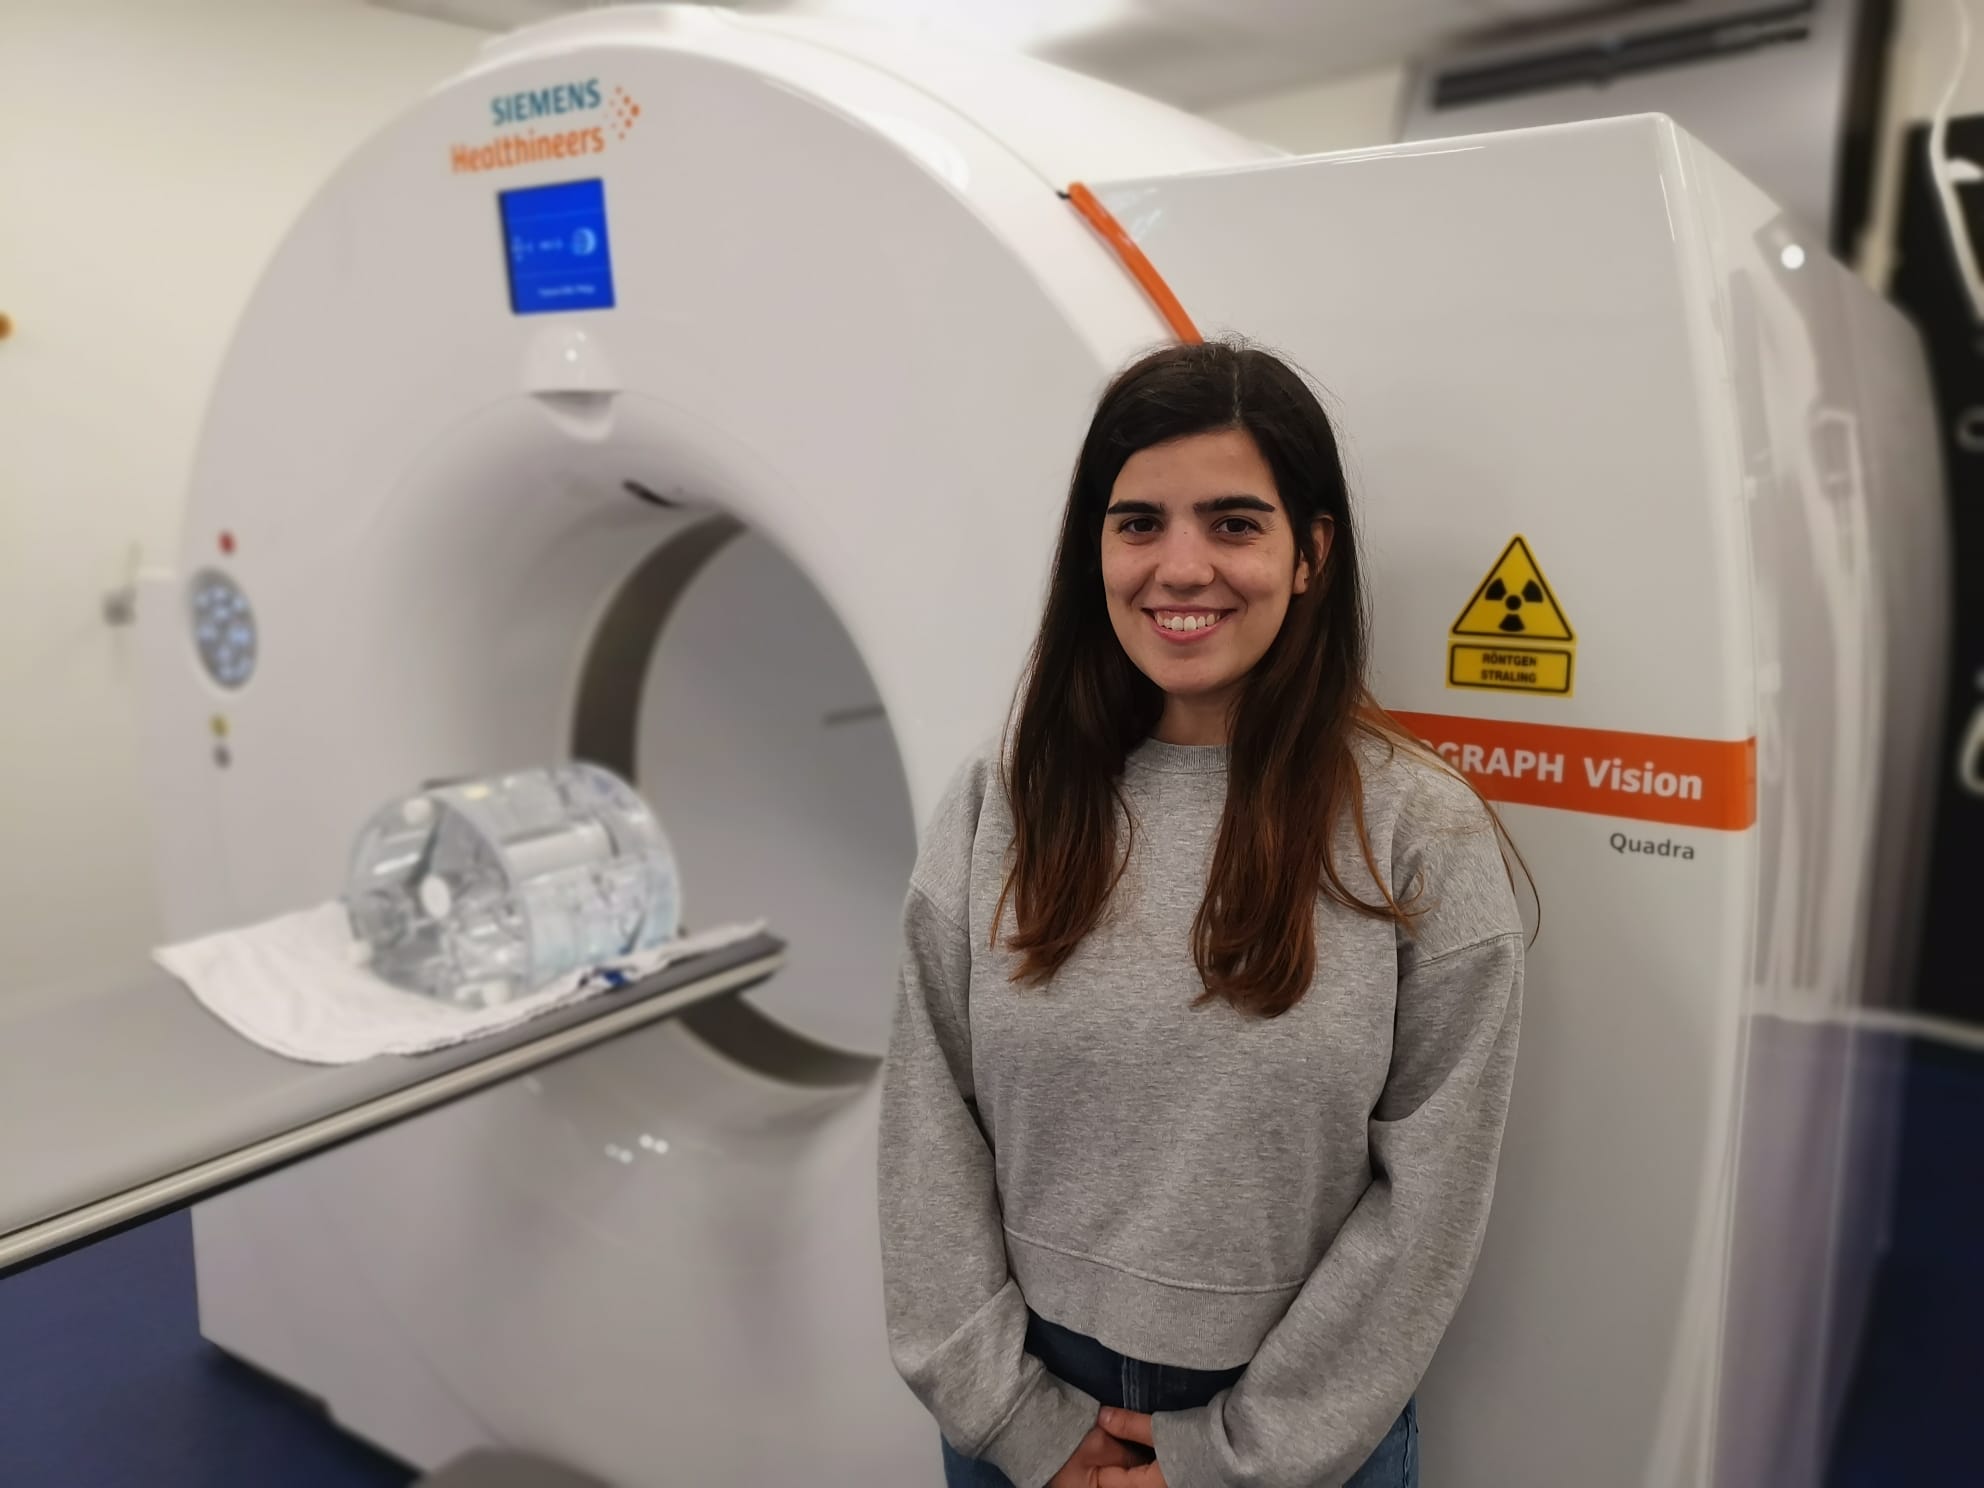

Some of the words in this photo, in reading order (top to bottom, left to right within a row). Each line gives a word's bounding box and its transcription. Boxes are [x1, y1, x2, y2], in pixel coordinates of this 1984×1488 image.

[491, 79, 601, 126] SIEMENS
[1482, 651, 1537, 667] RÖNTGEN
[1481, 669, 1537, 684] STRALING
[1420, 739, 1565, 784] GRAPH
[1583, 757, 1703, 800] Vision
[1609, 832, 1695, 860] Quadra
